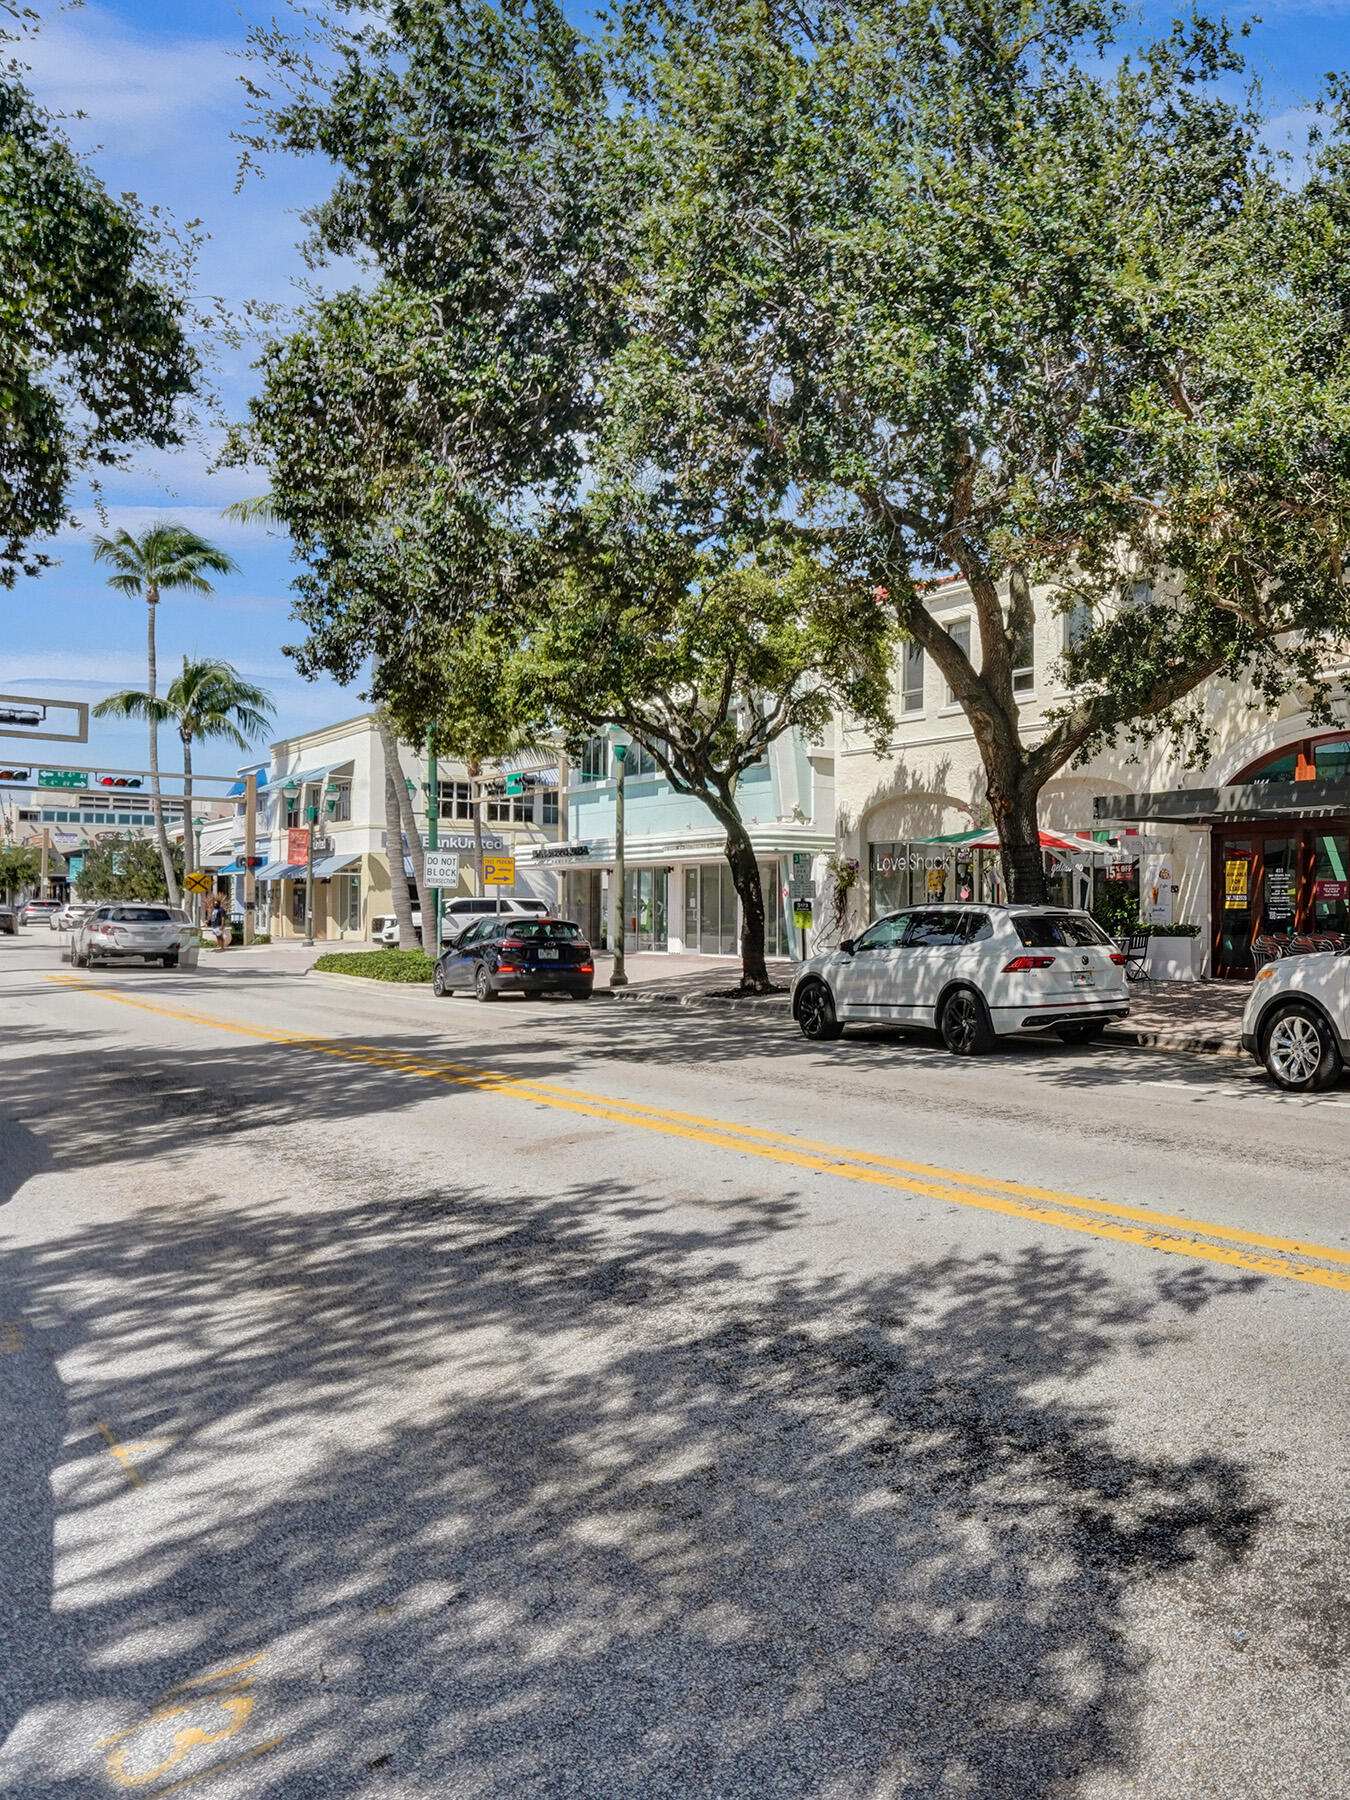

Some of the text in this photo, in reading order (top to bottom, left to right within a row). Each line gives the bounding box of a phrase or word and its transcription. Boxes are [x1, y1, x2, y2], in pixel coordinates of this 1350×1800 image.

[422, 836, 502, 850] BnkUnted
[427, 857, 457, 866] DO NOT
[876, 851, 950, 871] Love Shack
[427, 868, 457, 877] BLOCK
[485, 865, 496, 881] P
